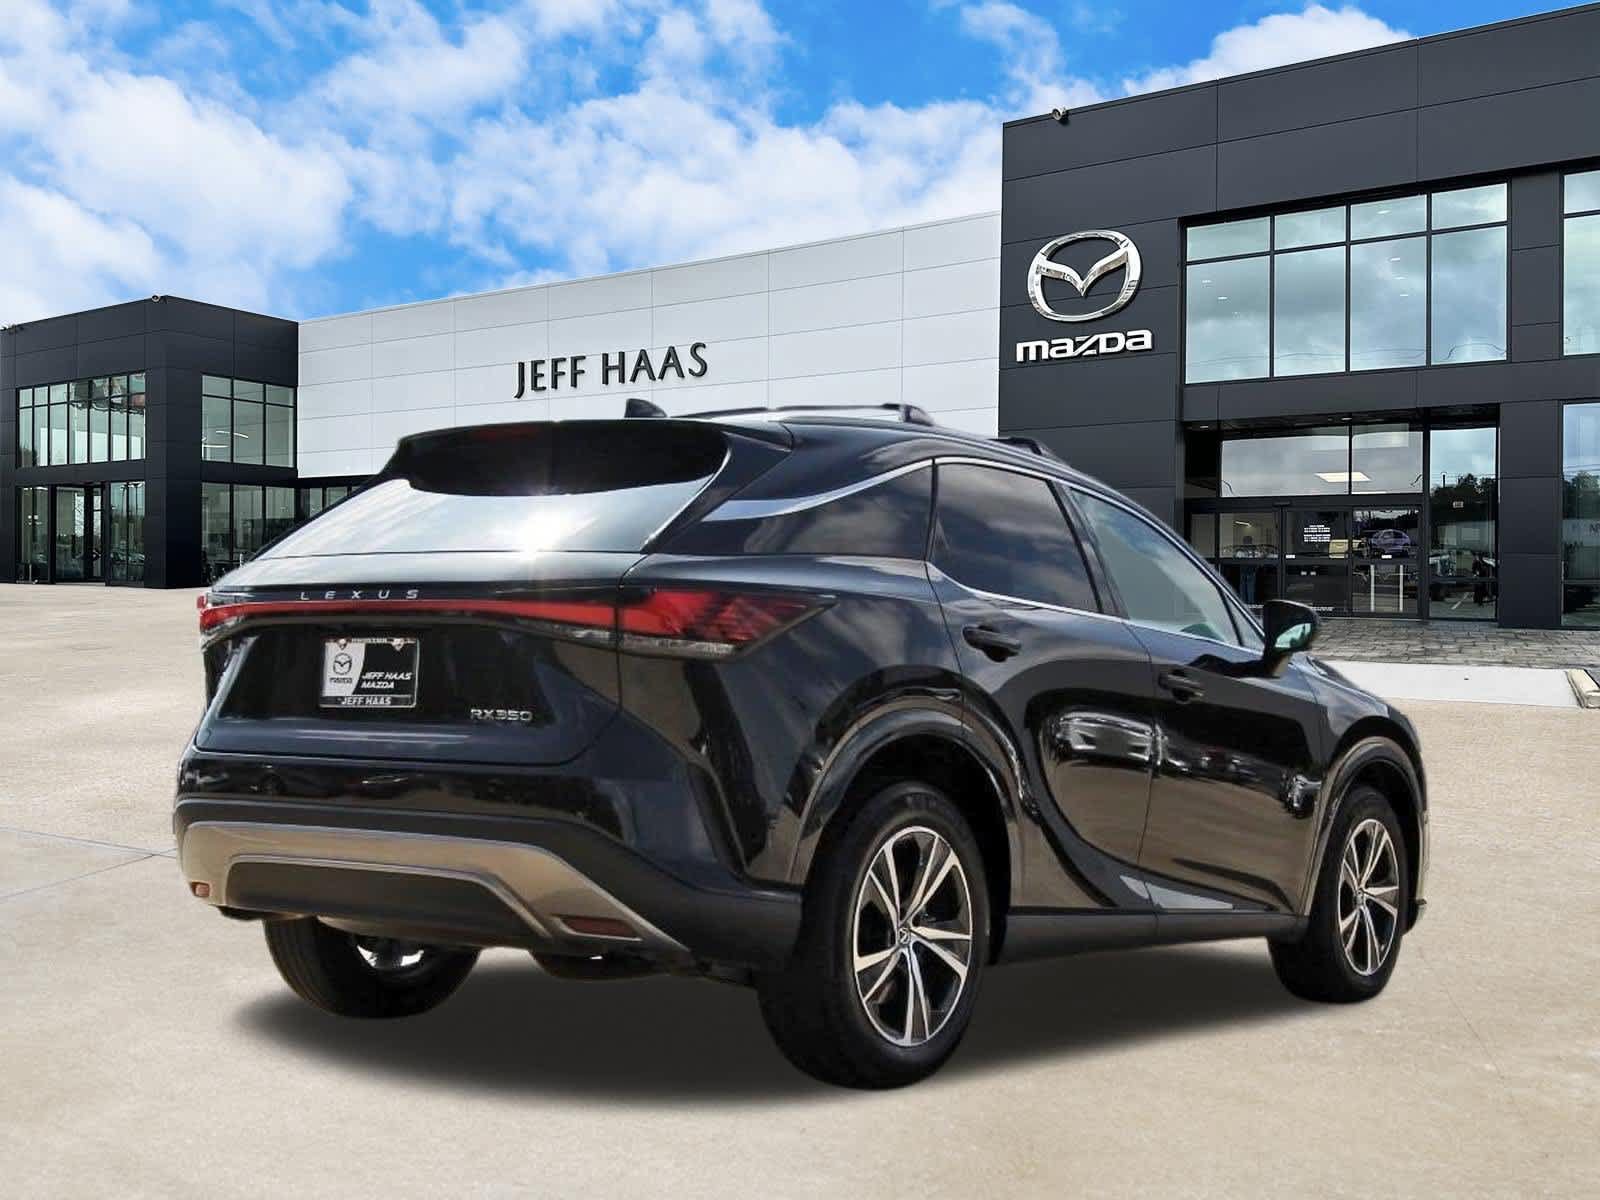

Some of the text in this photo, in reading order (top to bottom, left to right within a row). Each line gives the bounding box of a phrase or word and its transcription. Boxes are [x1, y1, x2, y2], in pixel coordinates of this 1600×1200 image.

[514, 342, 709, 399] JEFF HAAS
[300, 589, 419, 600] LEXUS
[361, 672, 413, 680] JEFF HAAS
[361, 681, 395, 689] MAZDA
[341, 697, 391, 705] JEFF HAAS
[470, 708, 533, 721] RX350
